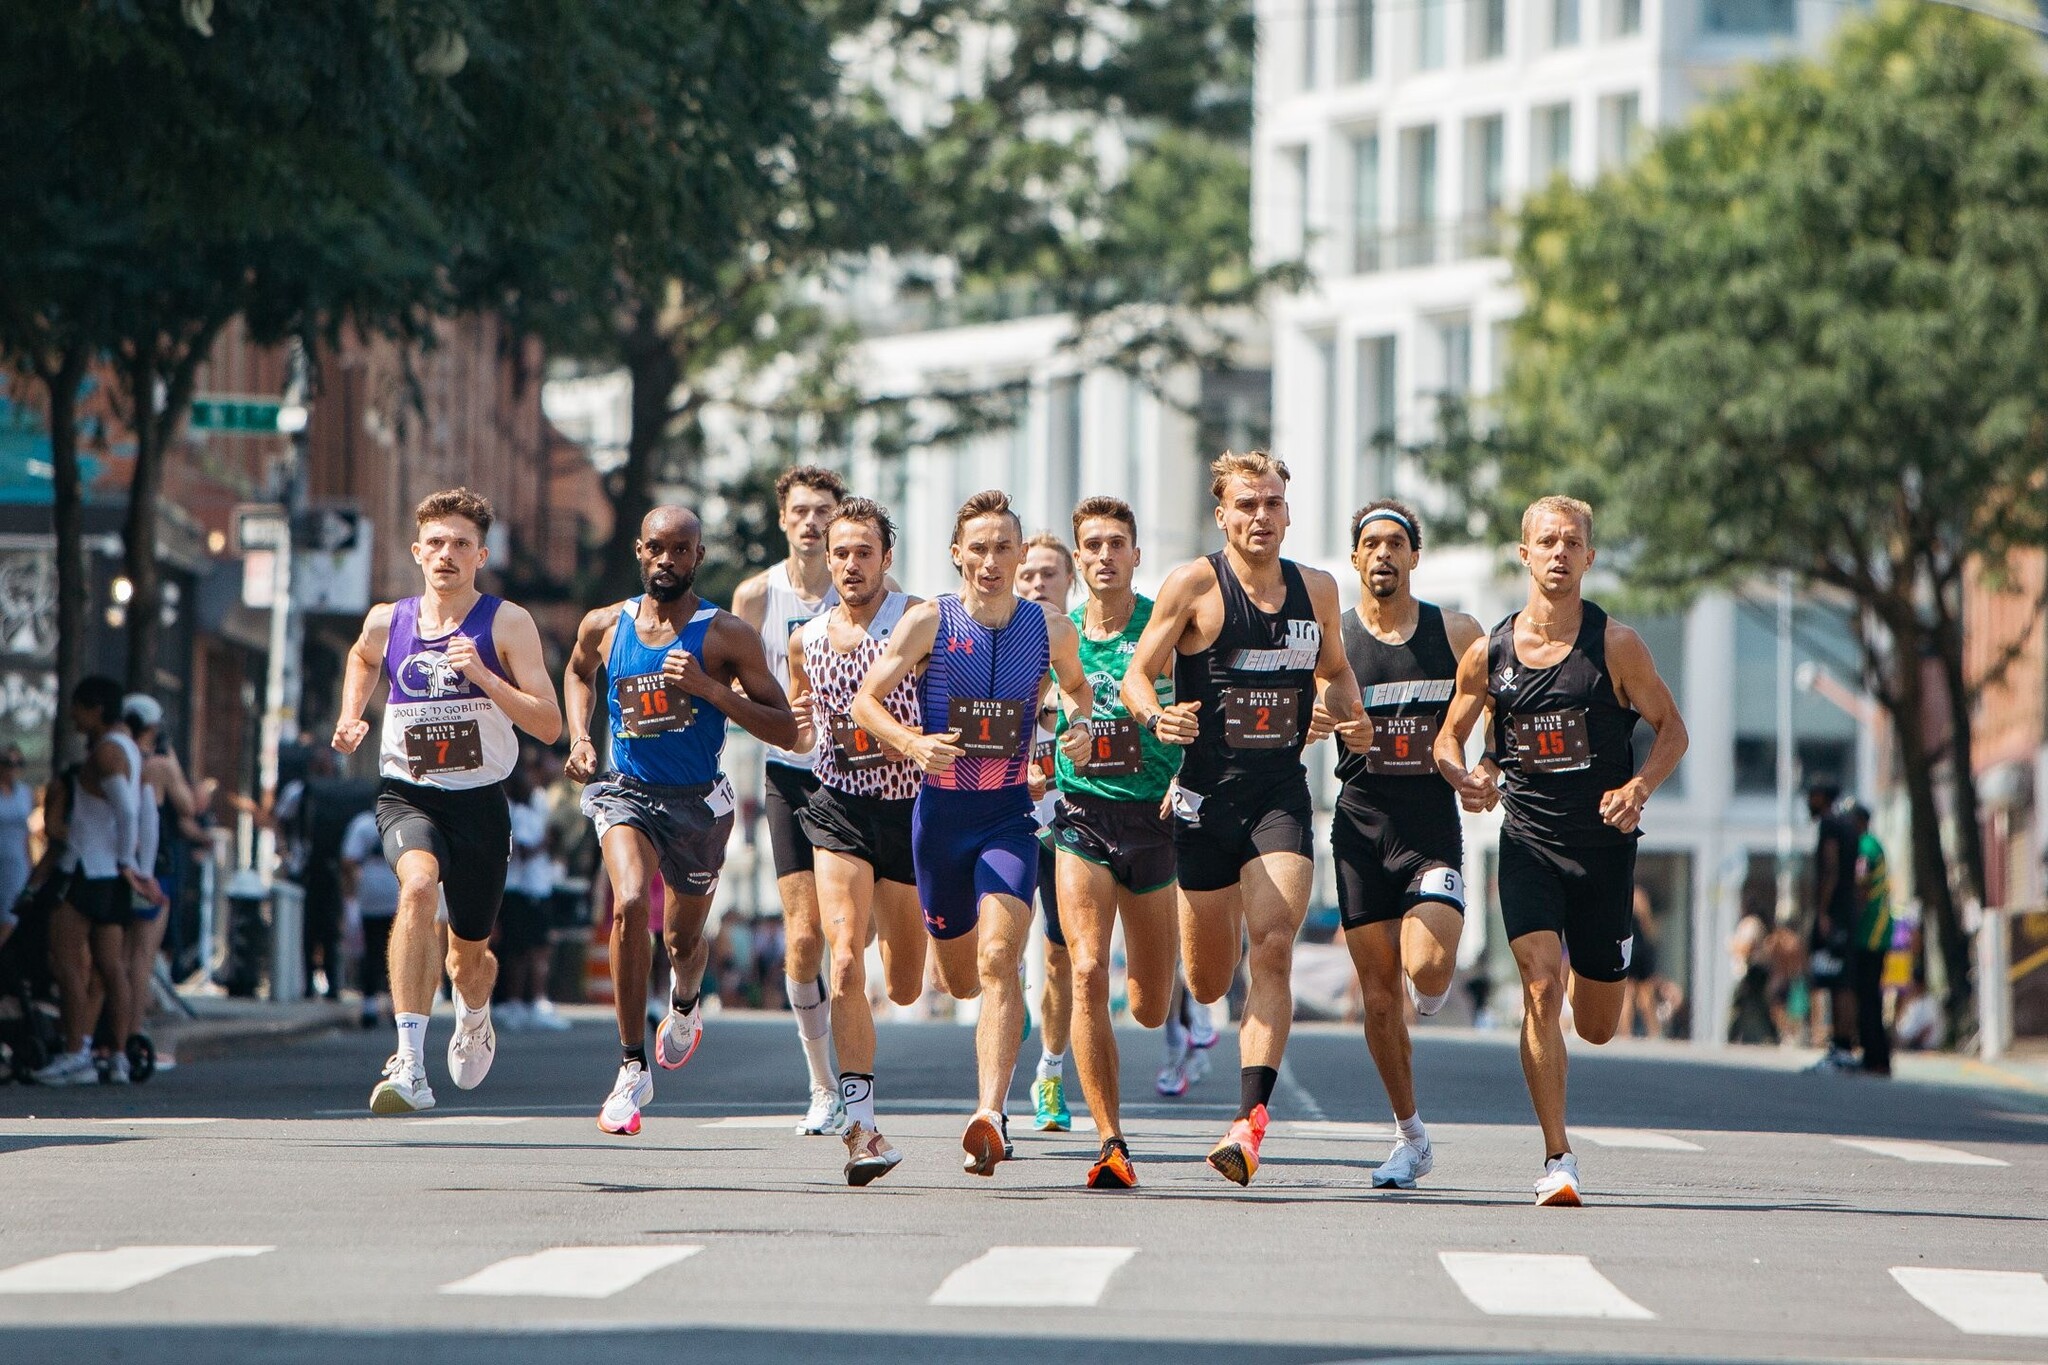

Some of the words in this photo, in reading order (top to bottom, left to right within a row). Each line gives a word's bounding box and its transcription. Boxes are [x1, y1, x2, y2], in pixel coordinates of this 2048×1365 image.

[637, 674, 664, 684] BKLYN
[638, 681, 666, 693] MILE
[1371, 679, 1455, 707] EMPIRE
[1250, 691, 1278, 699] BKLYN
[640, 690, 669, 717] 16
[973, 701, 1002, 709] BKLYN
[972, 708, 1001, 717] MILE
[1255, 707, 1270, 731] 2
[1534, 715, 1562, 723] BKLYN
[426, 725, 455, 733] BKLYN
[979, 717, 991, 741] 1
[1092, 721, 1116, 729] KLYN
[1388, 719, 1416, 727] BKLYN
[1534, 722, 1562, 732] MILE
[427, 732, 455, 741] MILE
[1388, 726, 1416, 735] MILE
[854, 729, 869, 752] 8
[1036, 743, 1050, 751] LYN
[1395, 734, 1409, 759] 5
[1537, 730, 1565, 756] 15
[434, 740, 450, 764] 7
[1098, 736, 1111, 759] 6
[720, 781, 734, 805] 16
[1175, 791, 1183, 811] 2
[1444, 873, 1455, 891] 5
[844, 1083, 857, 1098] C
